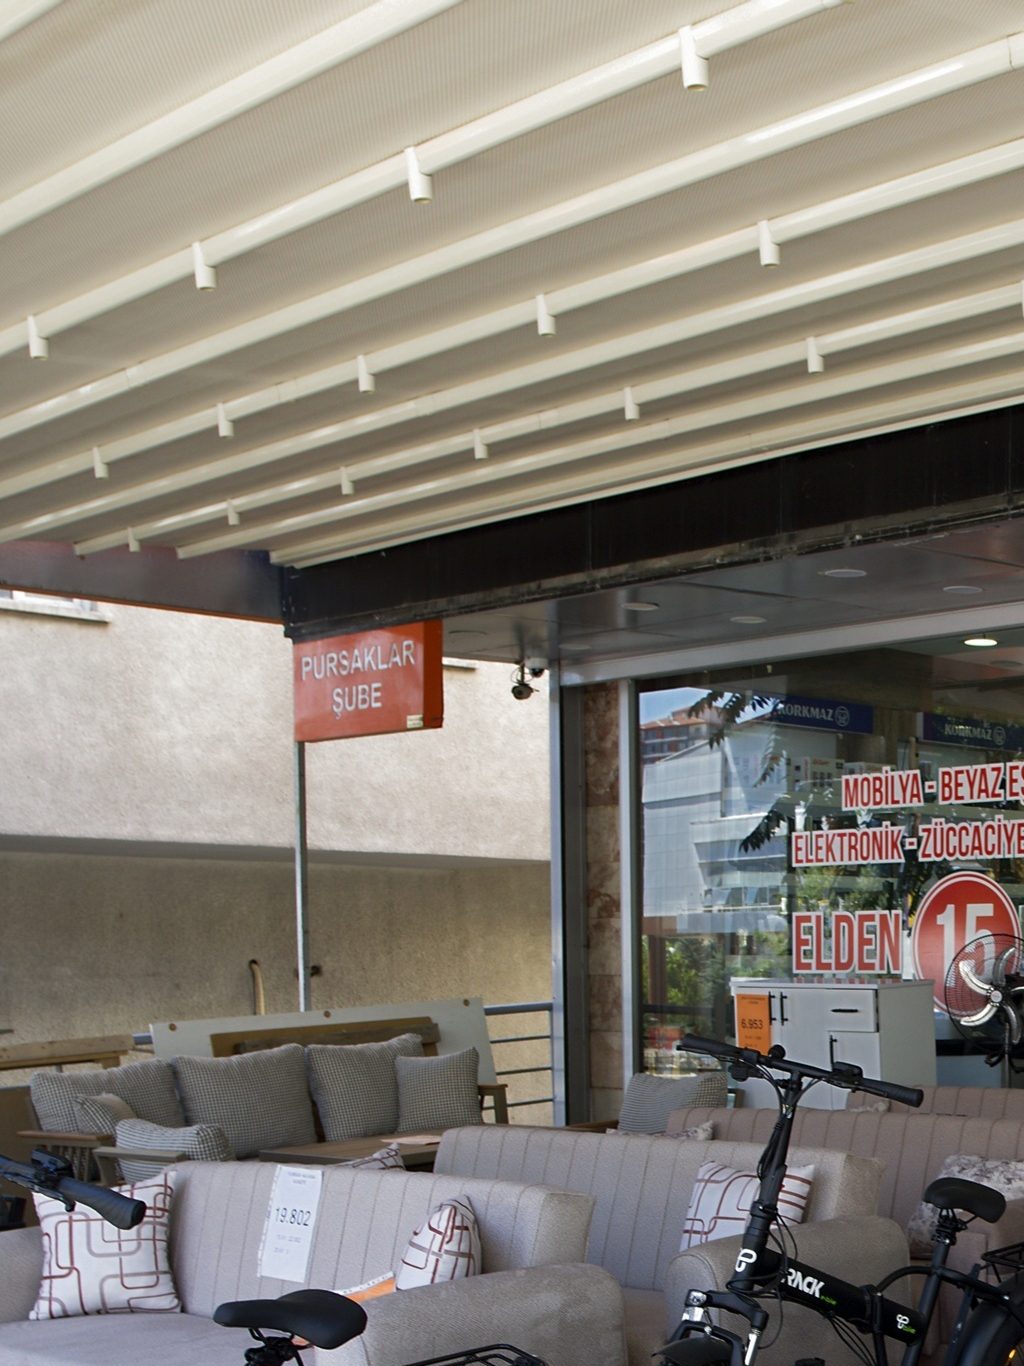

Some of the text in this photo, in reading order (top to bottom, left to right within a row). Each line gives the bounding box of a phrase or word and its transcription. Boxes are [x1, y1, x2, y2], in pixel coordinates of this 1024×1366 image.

[301, 640, 415, 681] PURSAKLAR
[332, 682, 382, 718] ŞUBE
[843, 768, 922, 809] MOBİLYA
[940, 765, 1002, 803] BEYAZ
[794, 824, 903, 865] ELEKTRONİK
[794, 911, 902, 973] ELDEN
[936, 903, 997, 984] 15
[276, 1207, 311, 1227] 19.802
[781, 1268, 825, 1299] RACK
